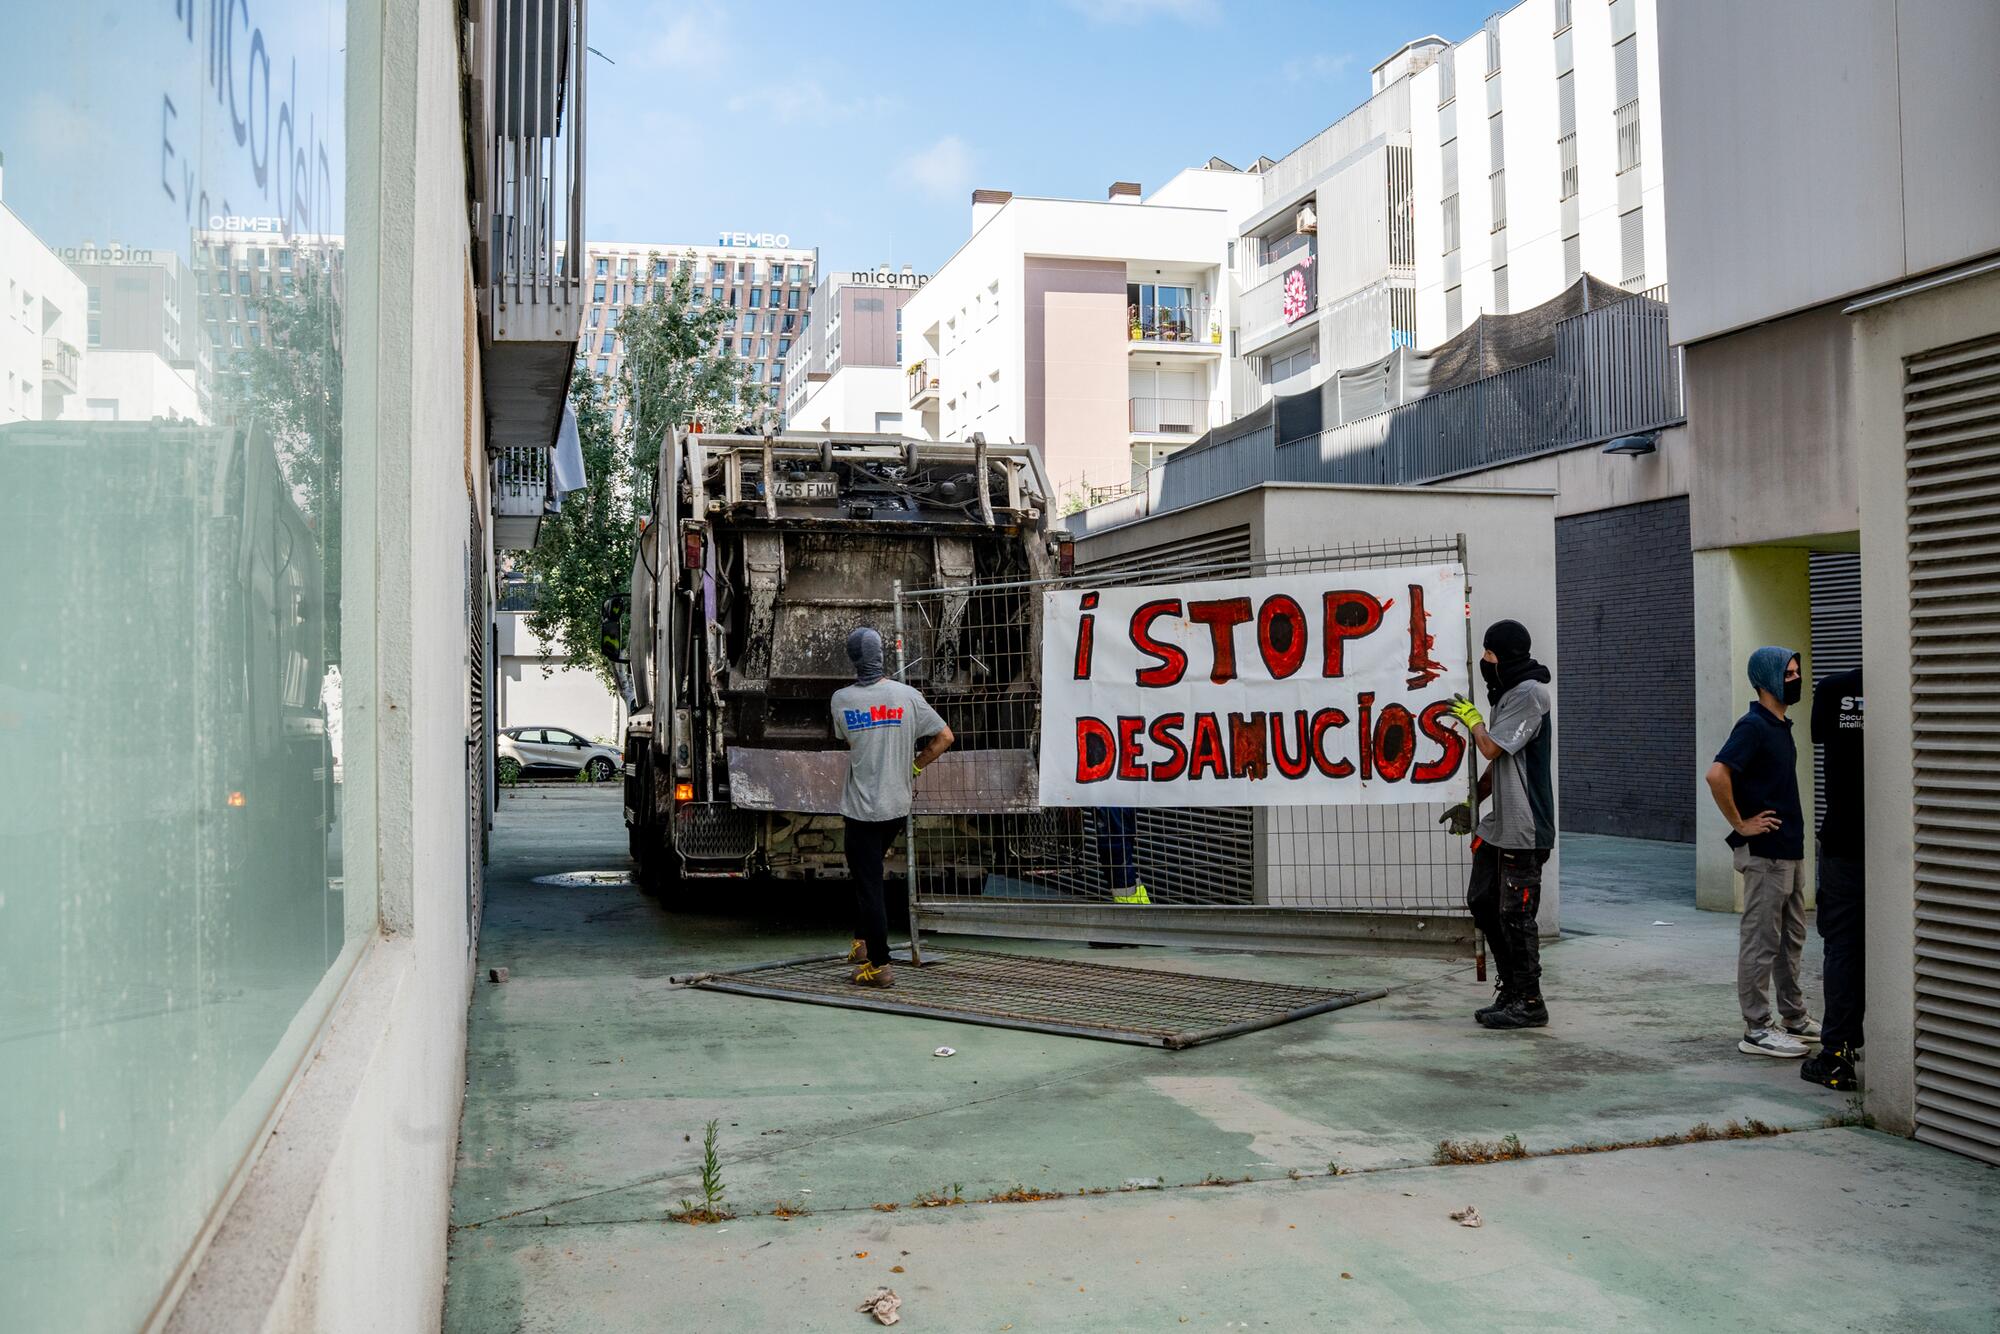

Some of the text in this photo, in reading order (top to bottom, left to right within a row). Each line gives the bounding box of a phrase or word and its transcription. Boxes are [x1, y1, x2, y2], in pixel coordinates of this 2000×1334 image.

[719, 231, 790, 249] TEMBO
[851, 268, 933, 289] micamp
[774, 483, 803, 497] 456
[843, 704, 904, 727] BigMat
